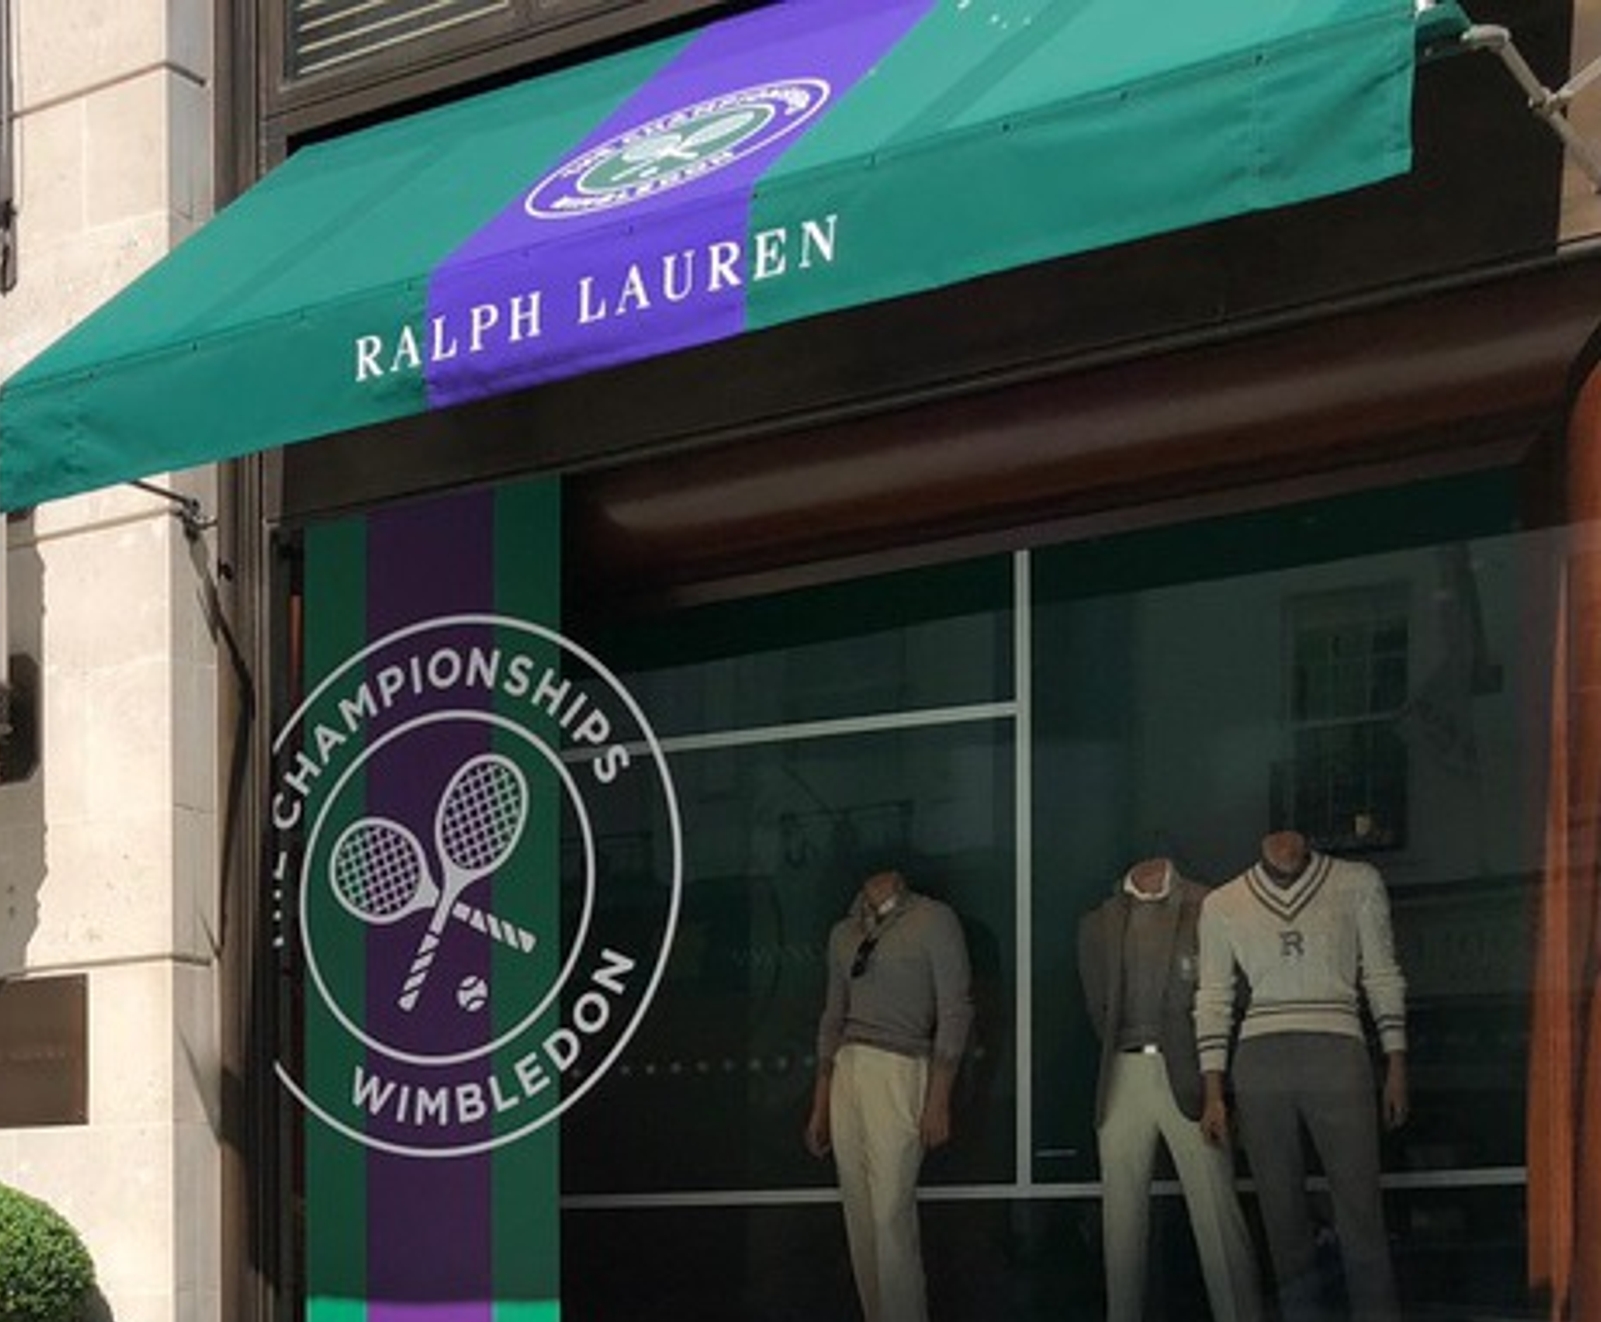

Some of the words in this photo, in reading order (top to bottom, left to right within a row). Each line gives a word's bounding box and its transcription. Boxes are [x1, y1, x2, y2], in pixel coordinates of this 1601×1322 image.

[354, 290, 543, 383] RALPH
[577, 213, 838, 325] LAUREN
[272, 646, 631, 830] CHAMPIONSHIPS
[1279, 930, 1305, 958] R
[352, 948, 636, 1127] WIMBLEDON
